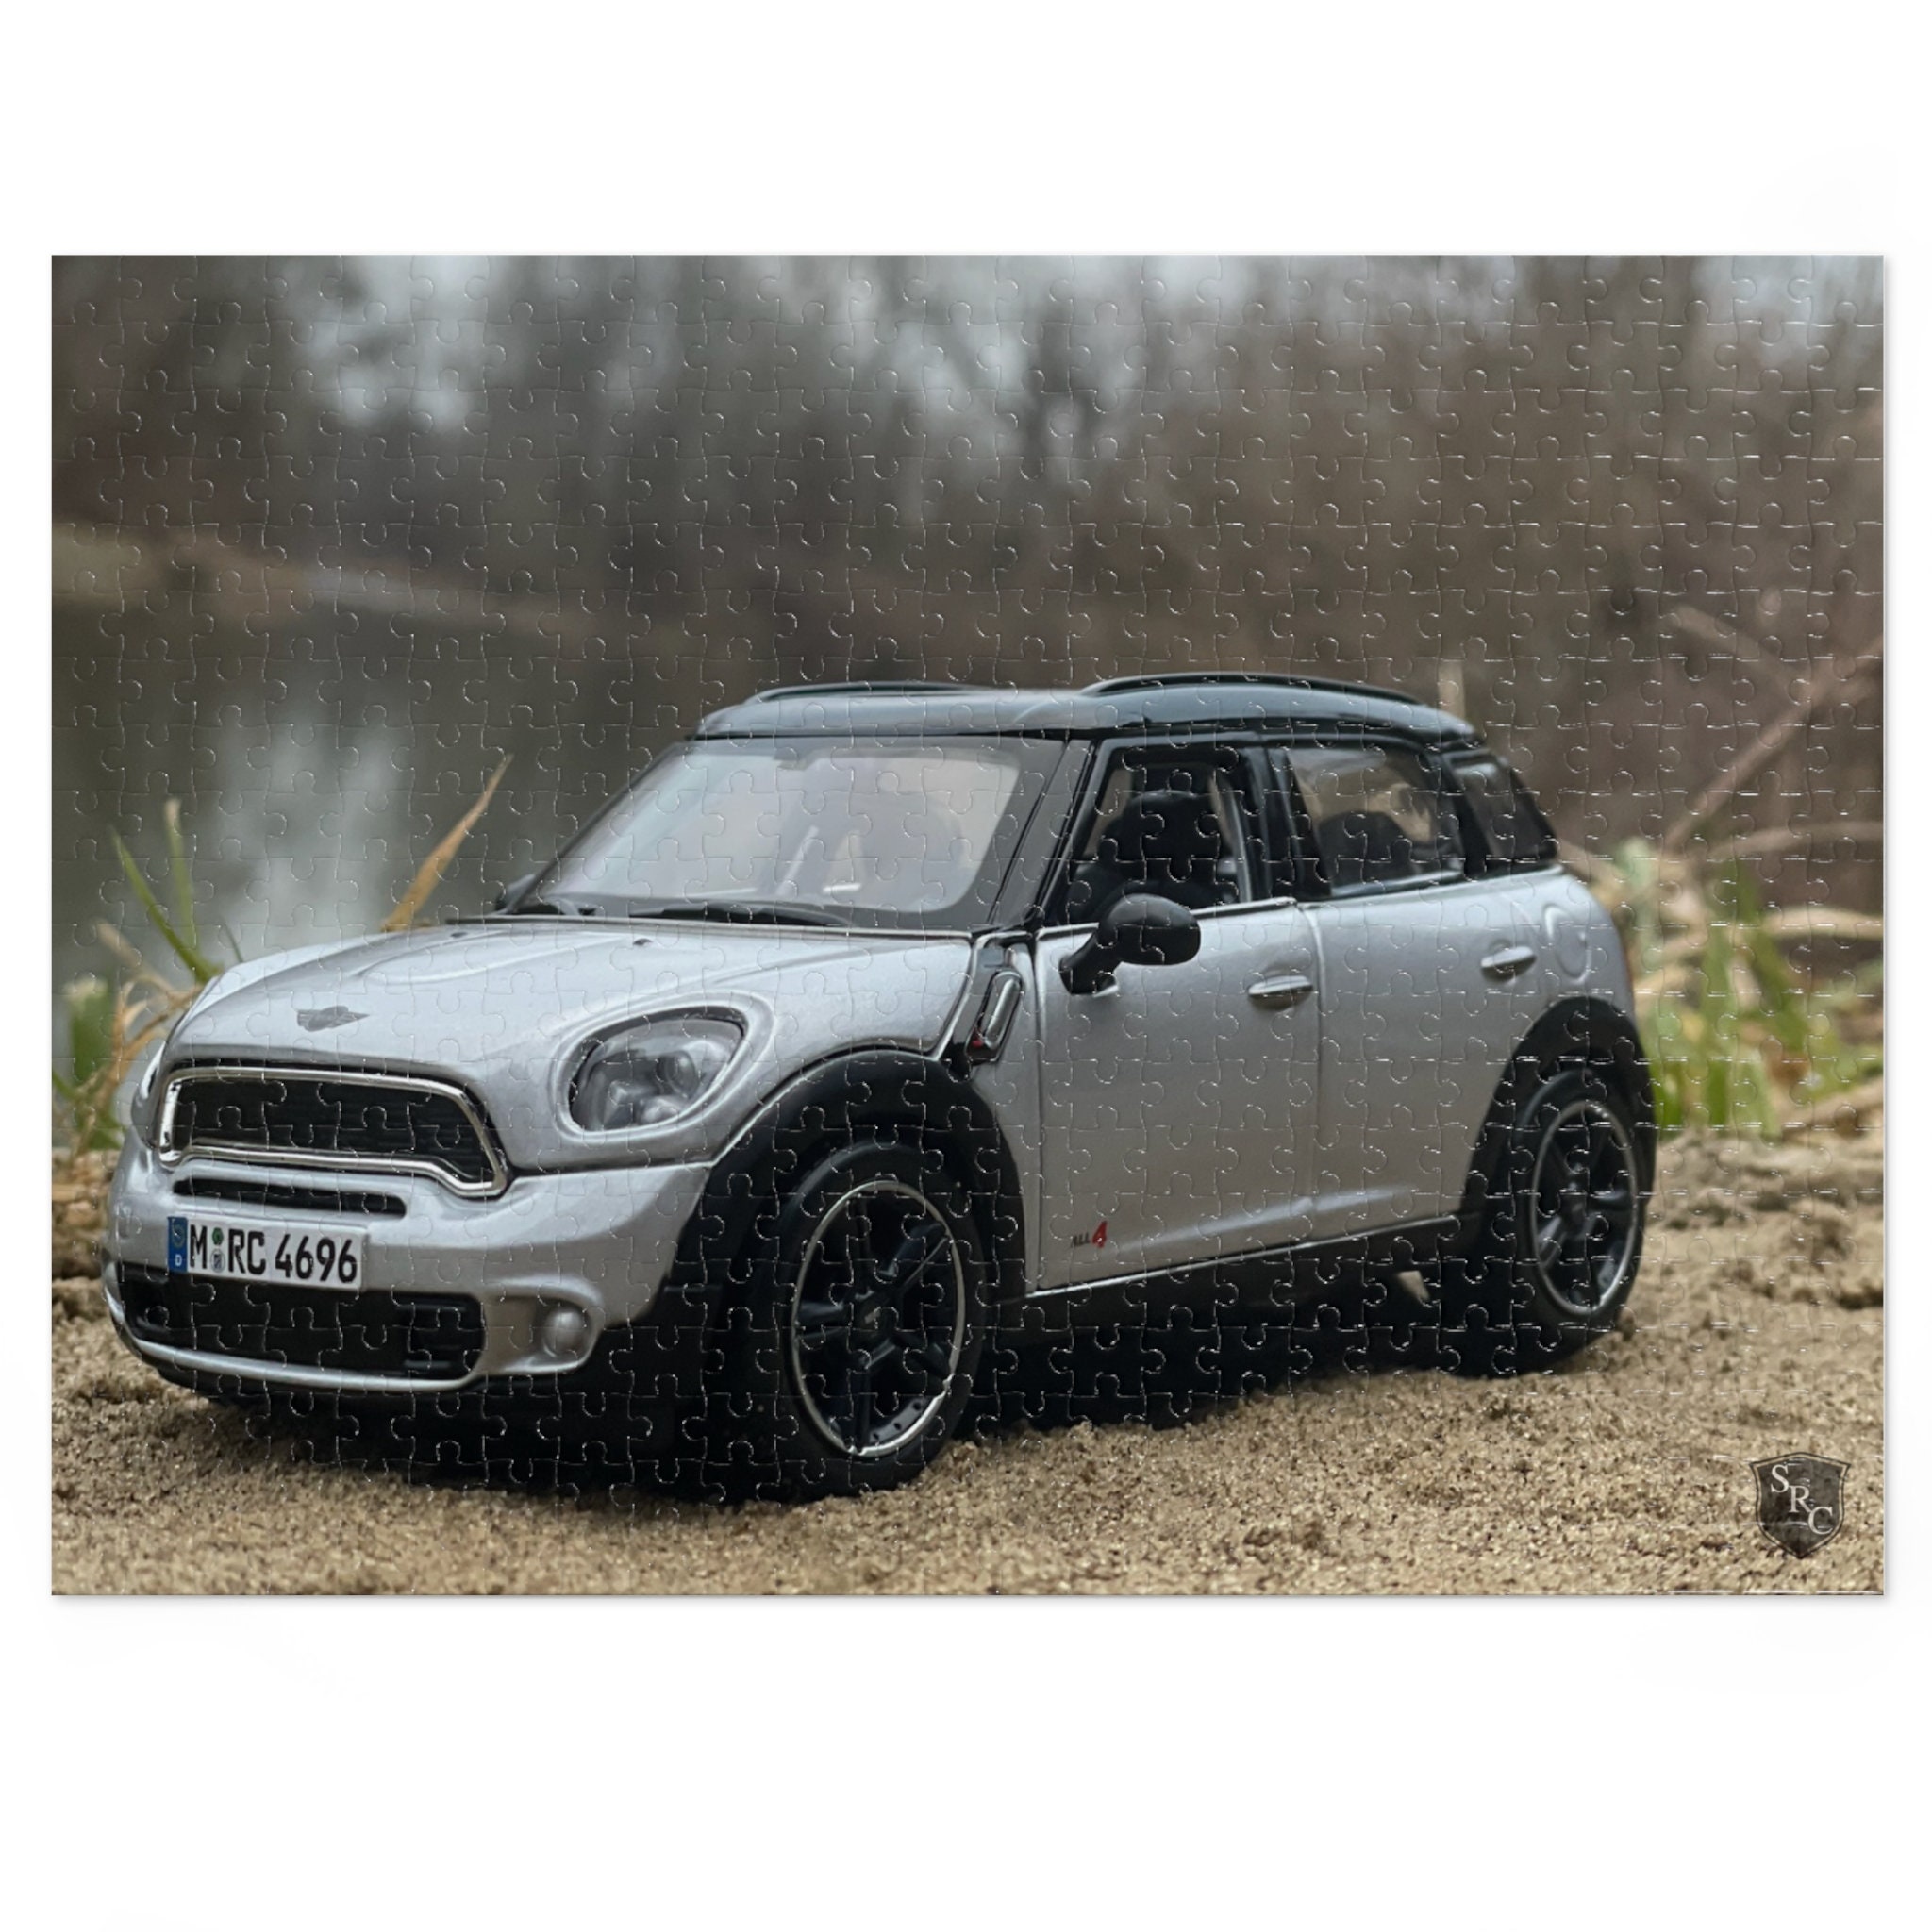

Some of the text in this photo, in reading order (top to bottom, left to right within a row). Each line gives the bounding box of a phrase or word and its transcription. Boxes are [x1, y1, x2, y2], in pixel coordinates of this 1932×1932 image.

[175, 1253, 183, 1267] D
[190, 1224, 358, 1284] M RC 4696
